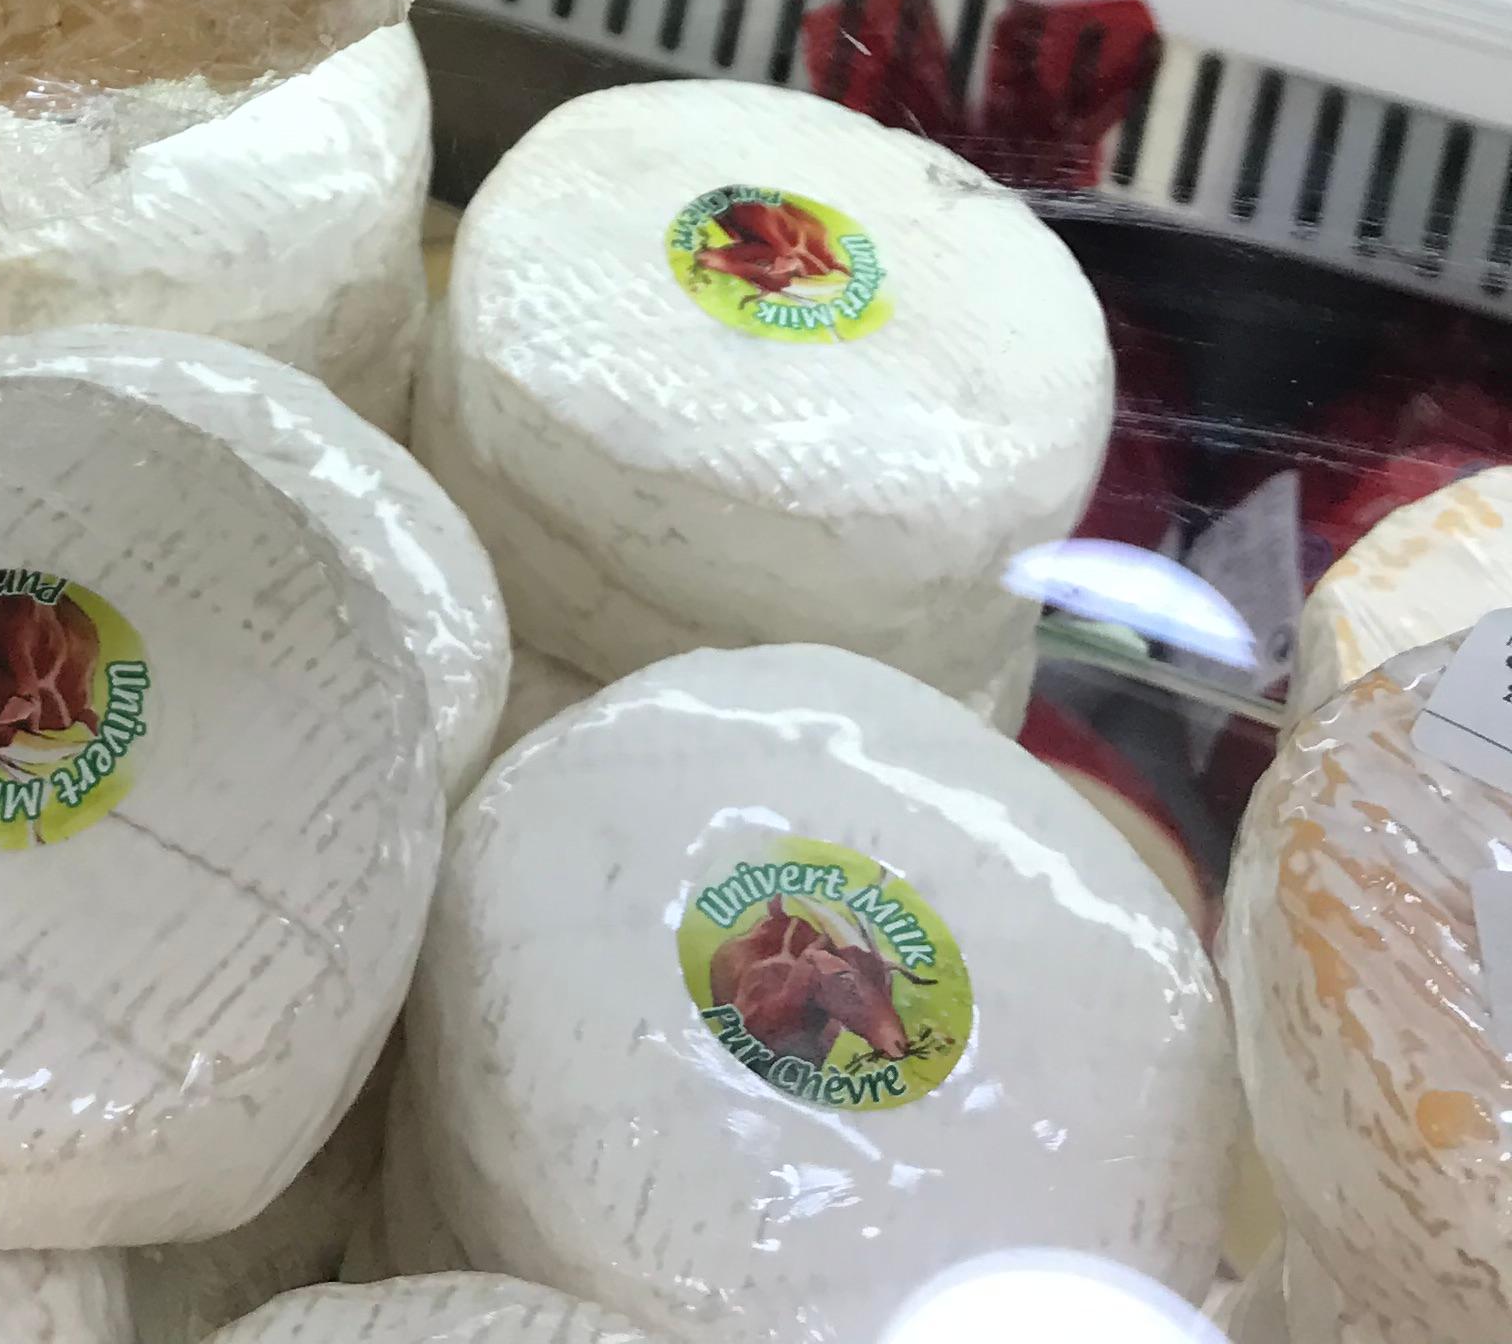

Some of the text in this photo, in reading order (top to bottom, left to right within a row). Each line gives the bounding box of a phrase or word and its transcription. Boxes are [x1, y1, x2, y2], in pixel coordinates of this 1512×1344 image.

[52, 661, 150, 808] Univert
[695, 861, 938, 968] Univert Milk
[766, 1055, 907, 1105] Chèvre
